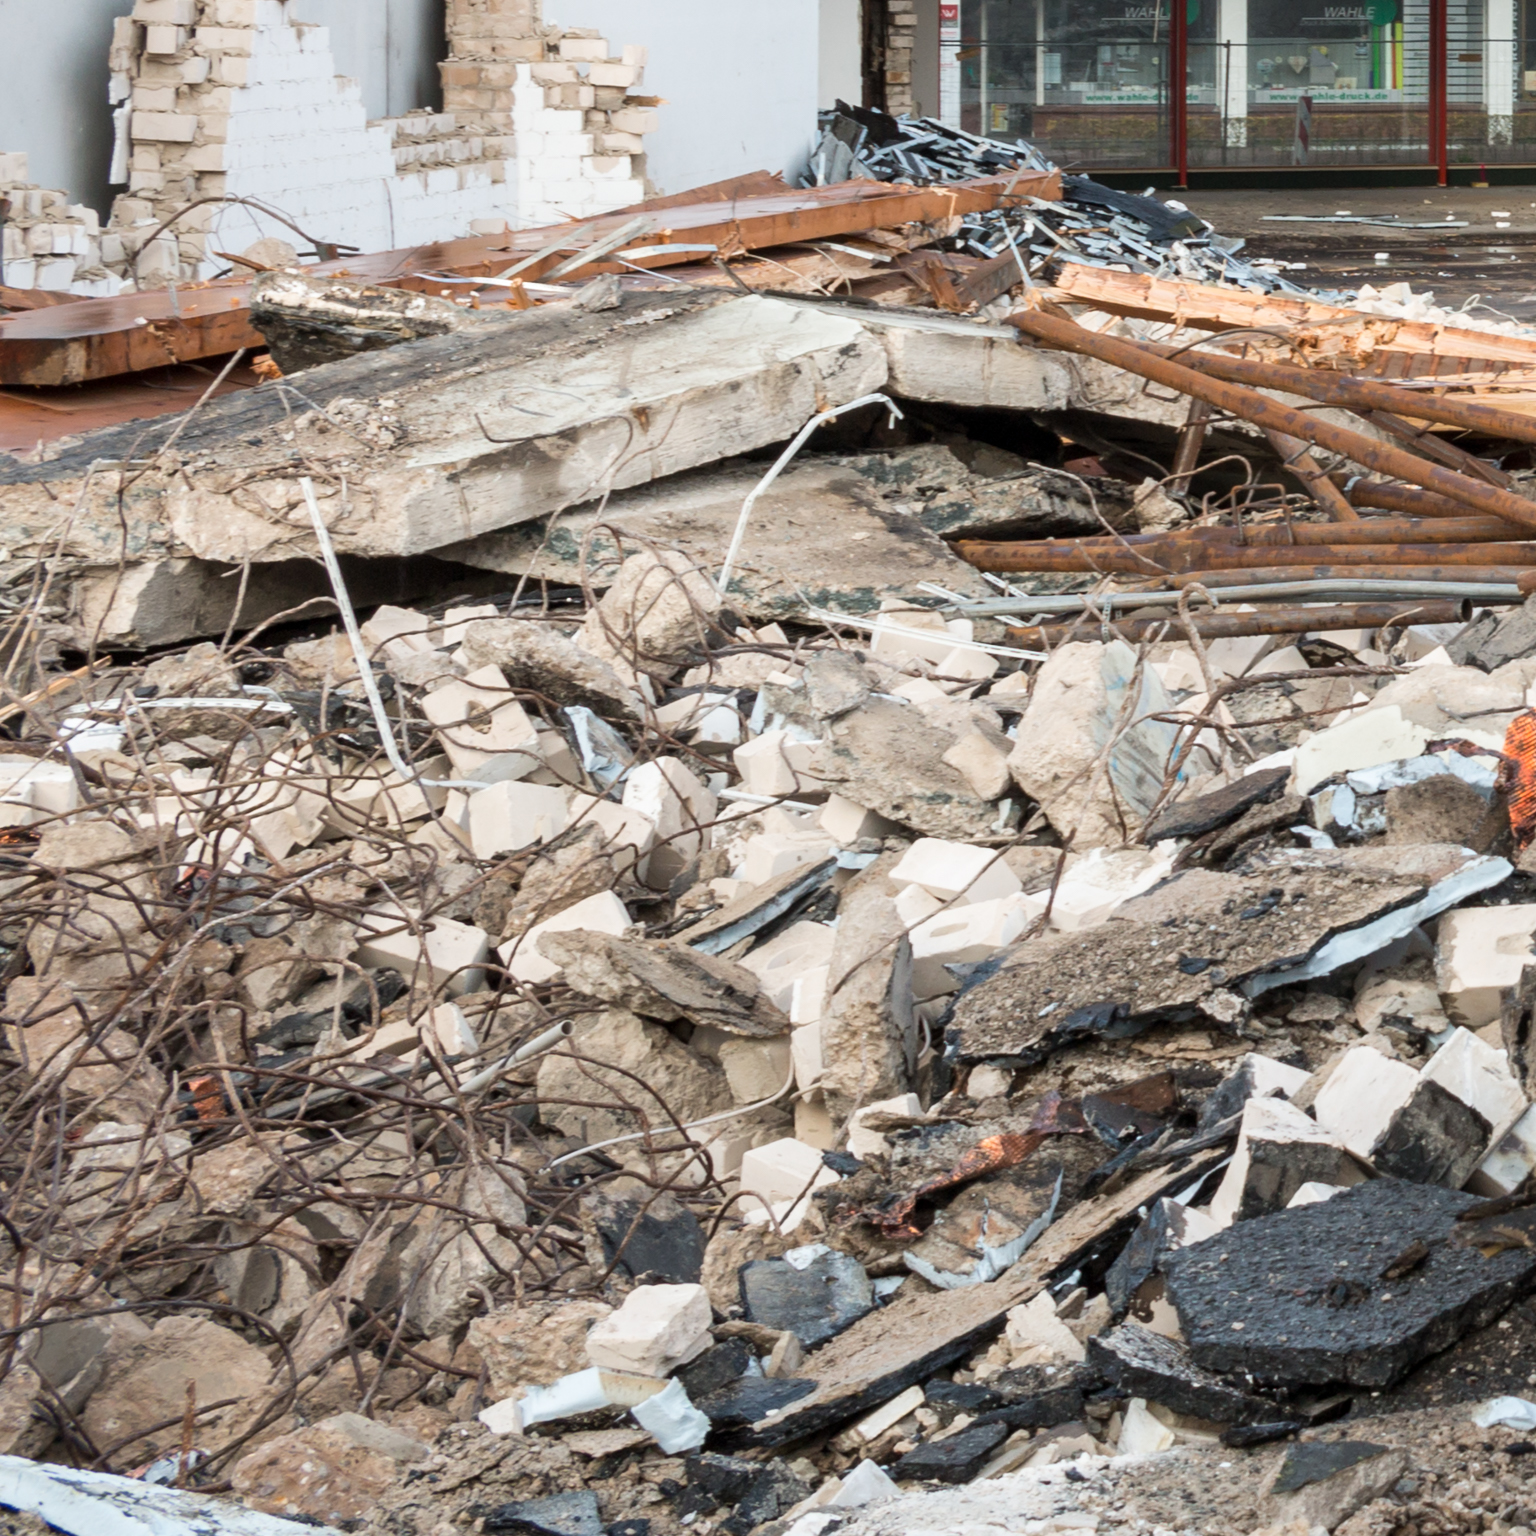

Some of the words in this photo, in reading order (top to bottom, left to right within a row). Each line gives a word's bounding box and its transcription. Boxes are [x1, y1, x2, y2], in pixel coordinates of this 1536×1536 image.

[1125, 7, 1171, 18] WAHL
[1324, 6, 1376, 18] WAHLE
[1269, 92, 1388, 101] wwwahle-druck.de
